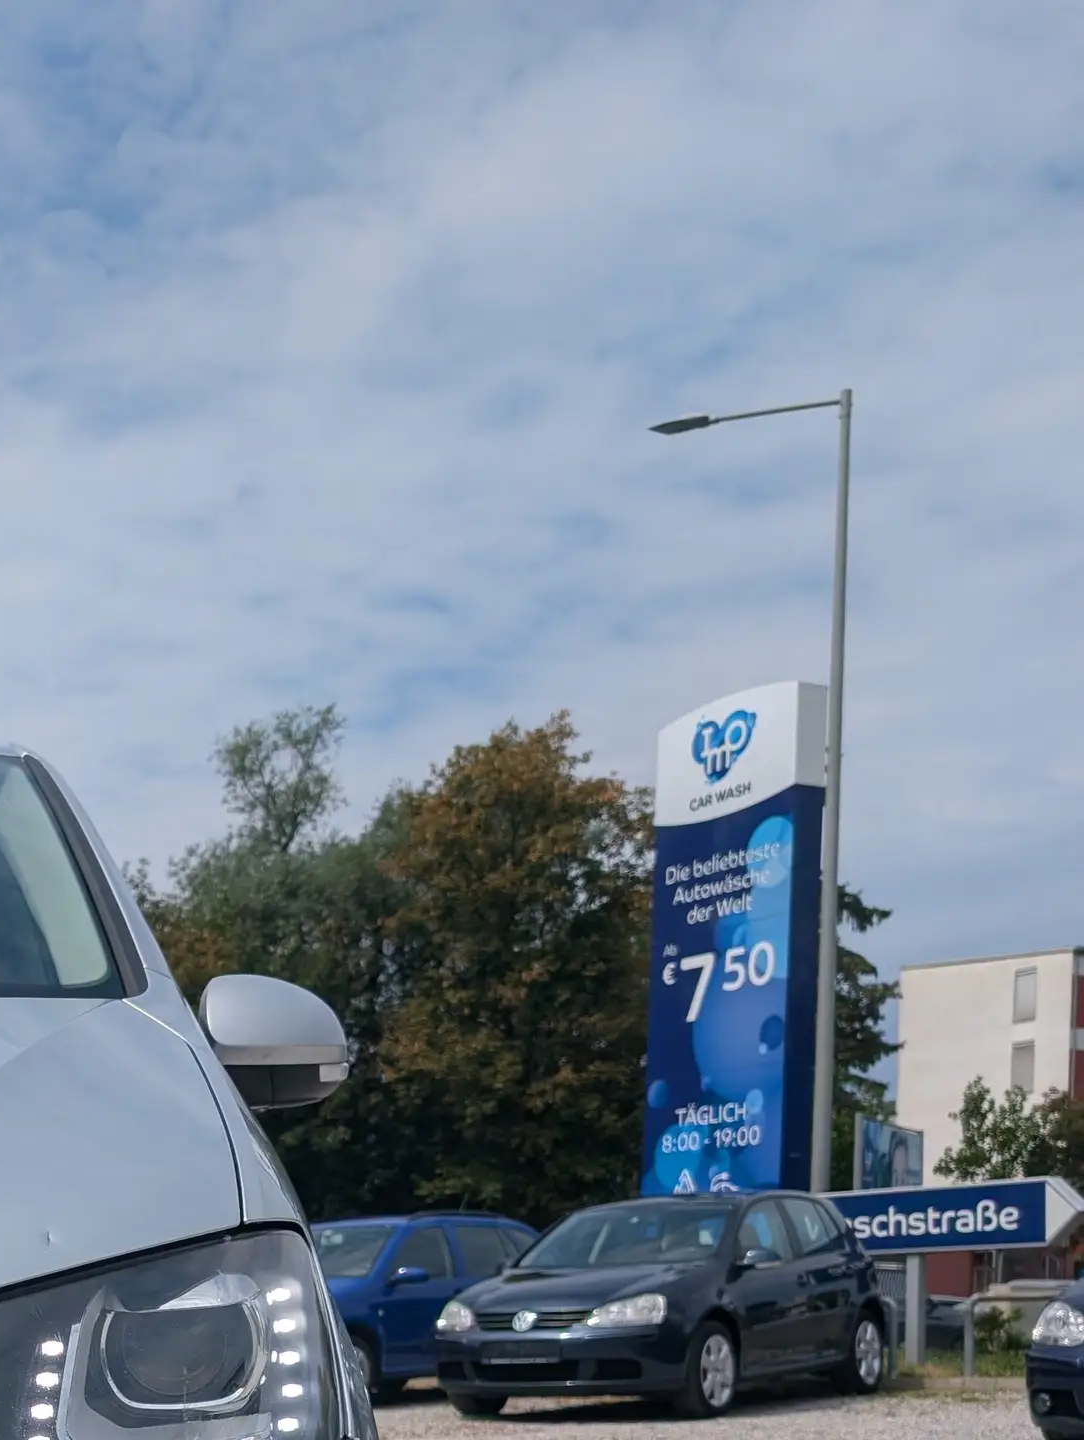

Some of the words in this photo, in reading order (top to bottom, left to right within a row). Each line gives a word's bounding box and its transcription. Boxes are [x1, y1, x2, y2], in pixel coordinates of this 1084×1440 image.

[689, 793, 713, 812] CAR
[715, 781, 751, 803] WASH
[665, 863, 690, 885] Die
[693, 841, 780, 877] beliebteste
[672, 868, 770, 905] Autowäsche
[686, 904, 714, 925] der
[715, 895, 753, 919] Welt
[674, 1102, 747, 1127] TÄGLICH
[661, 1131, 700, 1153] 8:00
[713, 1125, 760, 1148] 19:00
[844, 1199, 1020, 1239] schstraße
